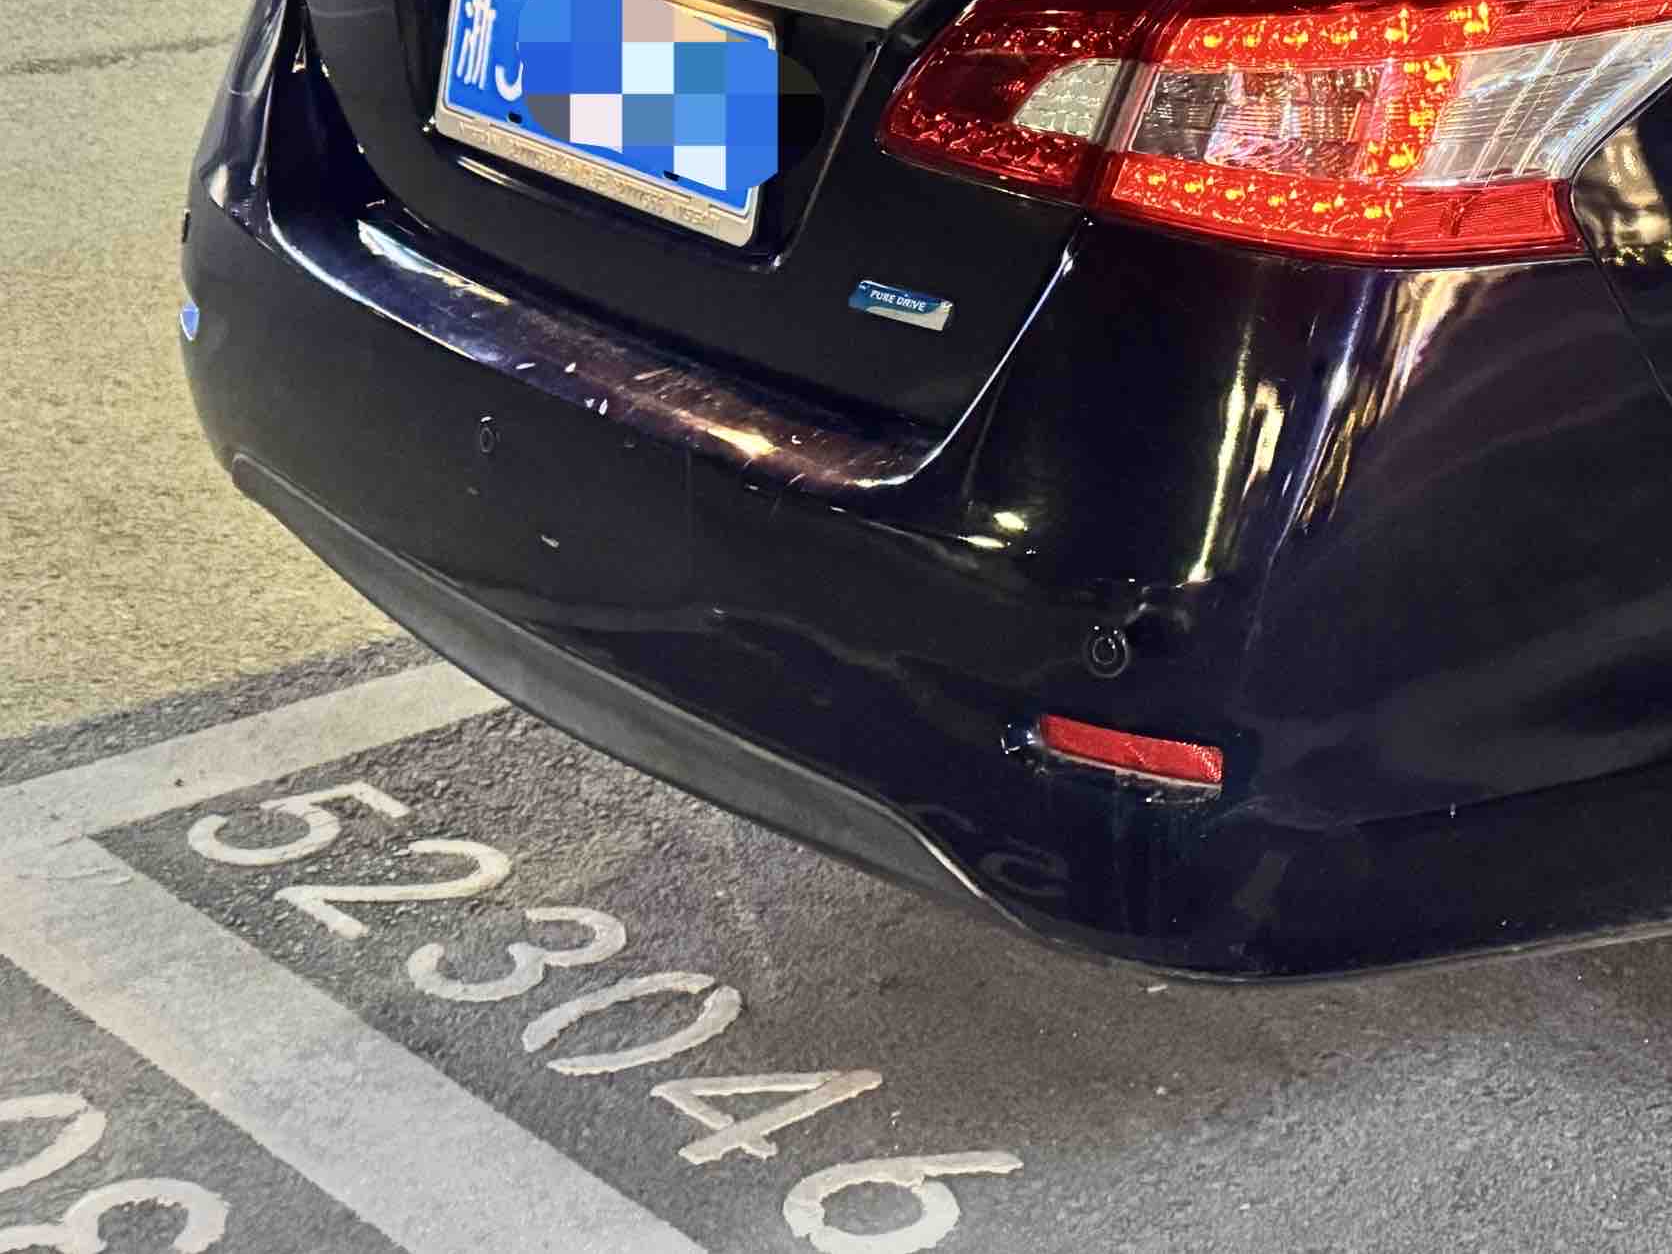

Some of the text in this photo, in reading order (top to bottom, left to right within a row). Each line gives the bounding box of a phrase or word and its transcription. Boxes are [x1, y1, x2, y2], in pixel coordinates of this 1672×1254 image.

[870, 290, 926, 312] PURE DRIVE
[187, 782, 1023, 1254] 523046
